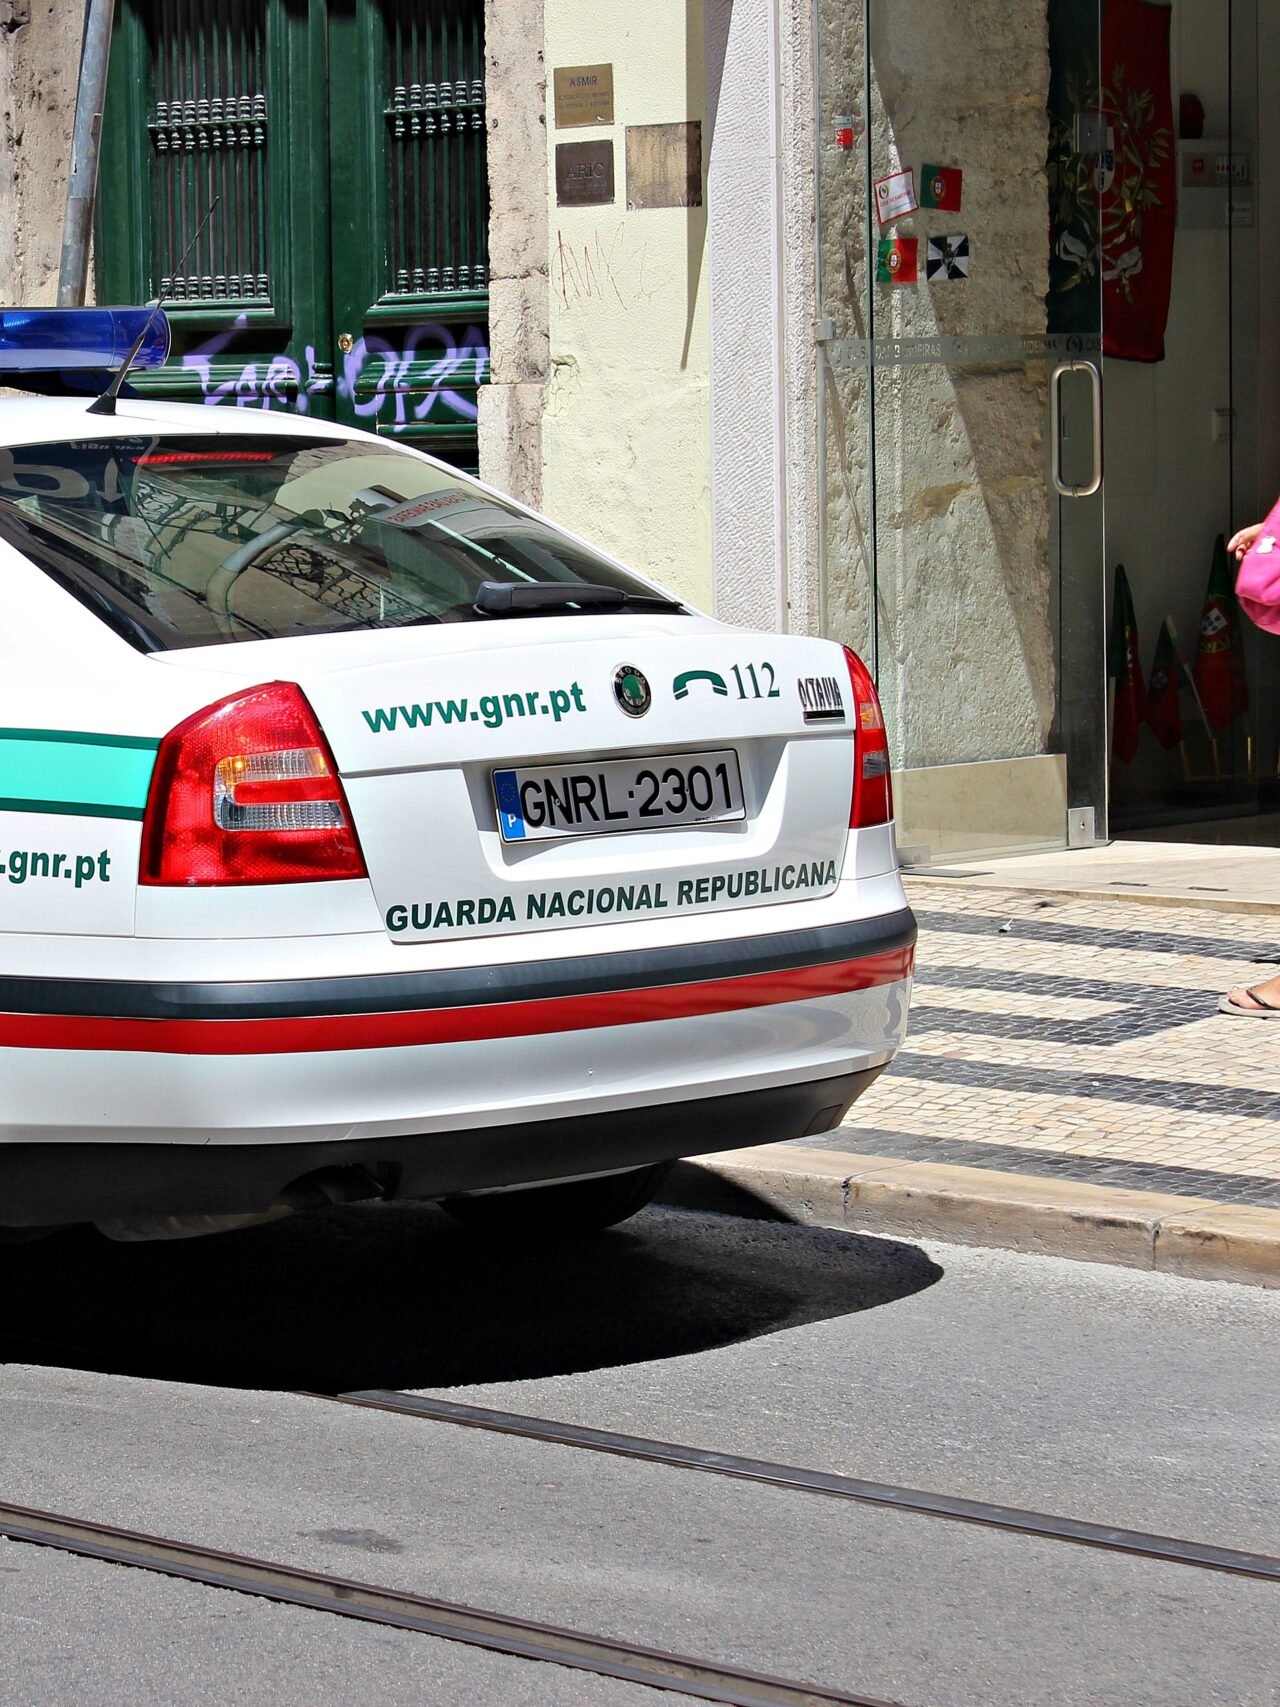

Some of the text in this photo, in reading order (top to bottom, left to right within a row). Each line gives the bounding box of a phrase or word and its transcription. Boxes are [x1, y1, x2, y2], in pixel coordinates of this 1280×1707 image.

[569, 75, 598, 88] ASMIR
[730, 661, 780, 700] 112
[797, 676, 844, 710] OCTAVIA
[362, 681, 587, 732] www.gnr.pt
[385, 859, 837, 932] GUARDA NACIONAL REPUBLICANA
